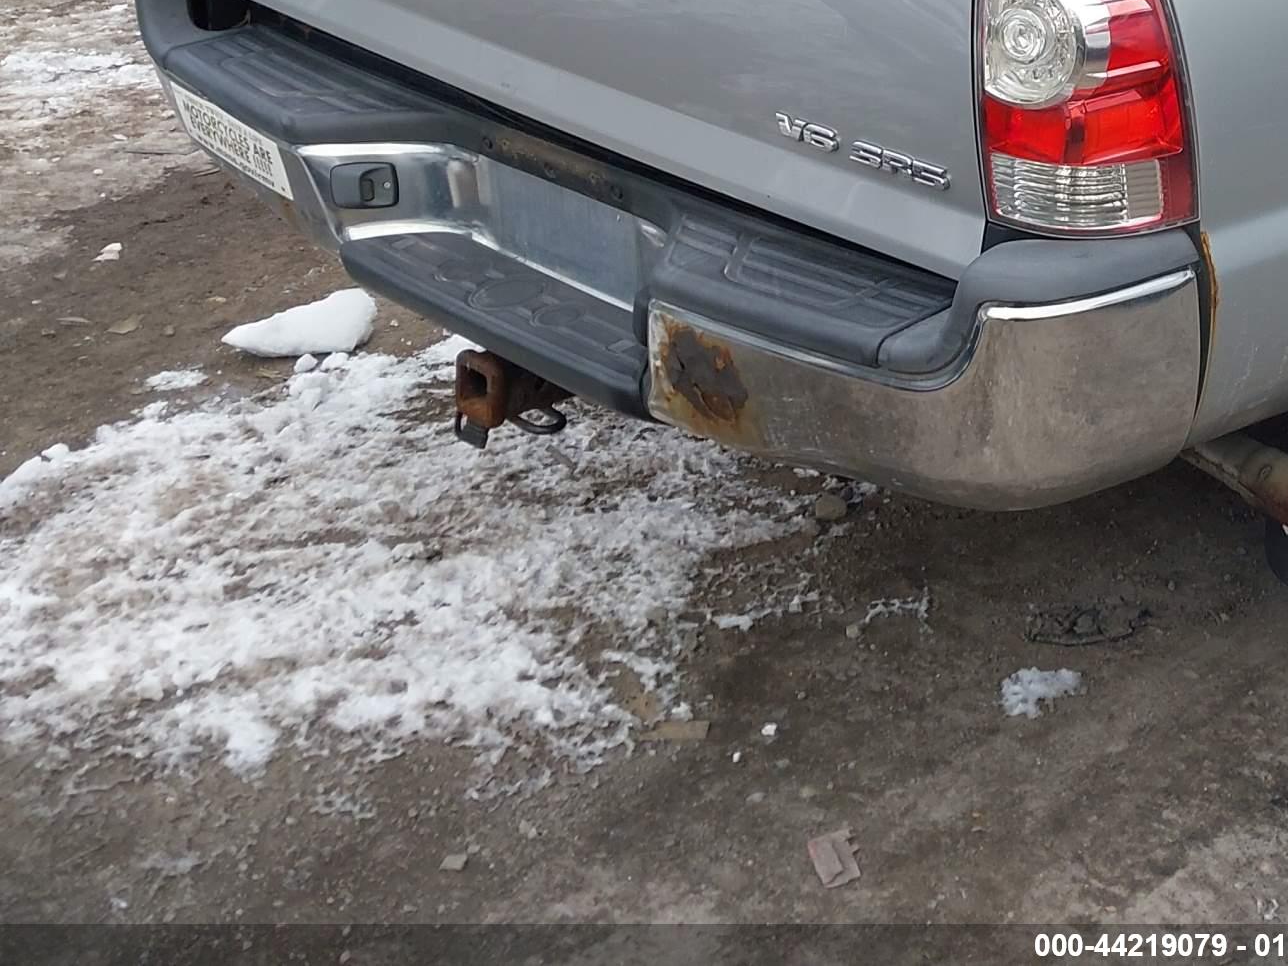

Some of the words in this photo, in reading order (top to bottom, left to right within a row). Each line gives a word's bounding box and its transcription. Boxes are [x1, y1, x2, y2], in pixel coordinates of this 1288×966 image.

[182, 99, 250, 150] MOTORCYCLES
[253, 143, 273, 165] ARE
[190, 116, 251, 163] EVERYWHERE
[775, 110, 842, 153] V6
[849, 139, 952, 191] SR5
